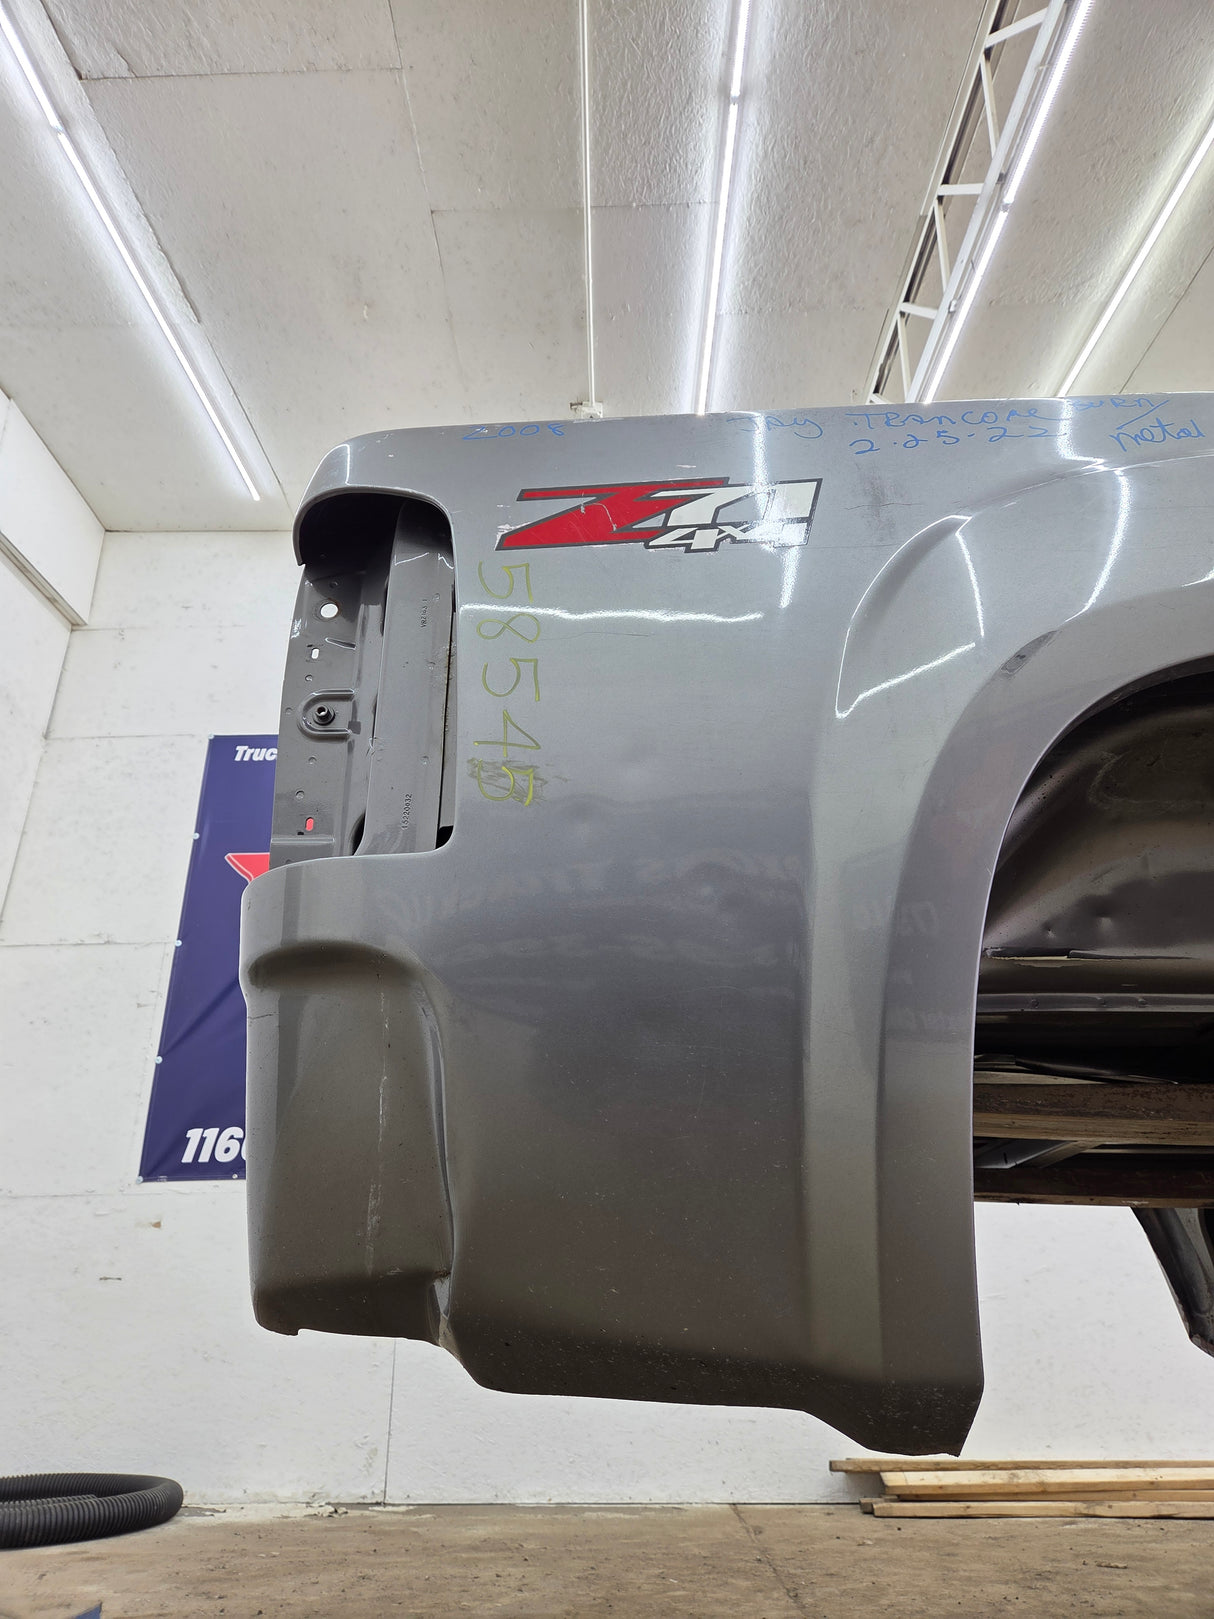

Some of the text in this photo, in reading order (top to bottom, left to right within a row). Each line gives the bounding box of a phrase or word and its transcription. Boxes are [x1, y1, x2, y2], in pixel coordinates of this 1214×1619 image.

[462, 422, 567, 441] 2008
[495, 477, 823, 551] Z71
[181, 1126, 247, 1163] 116
